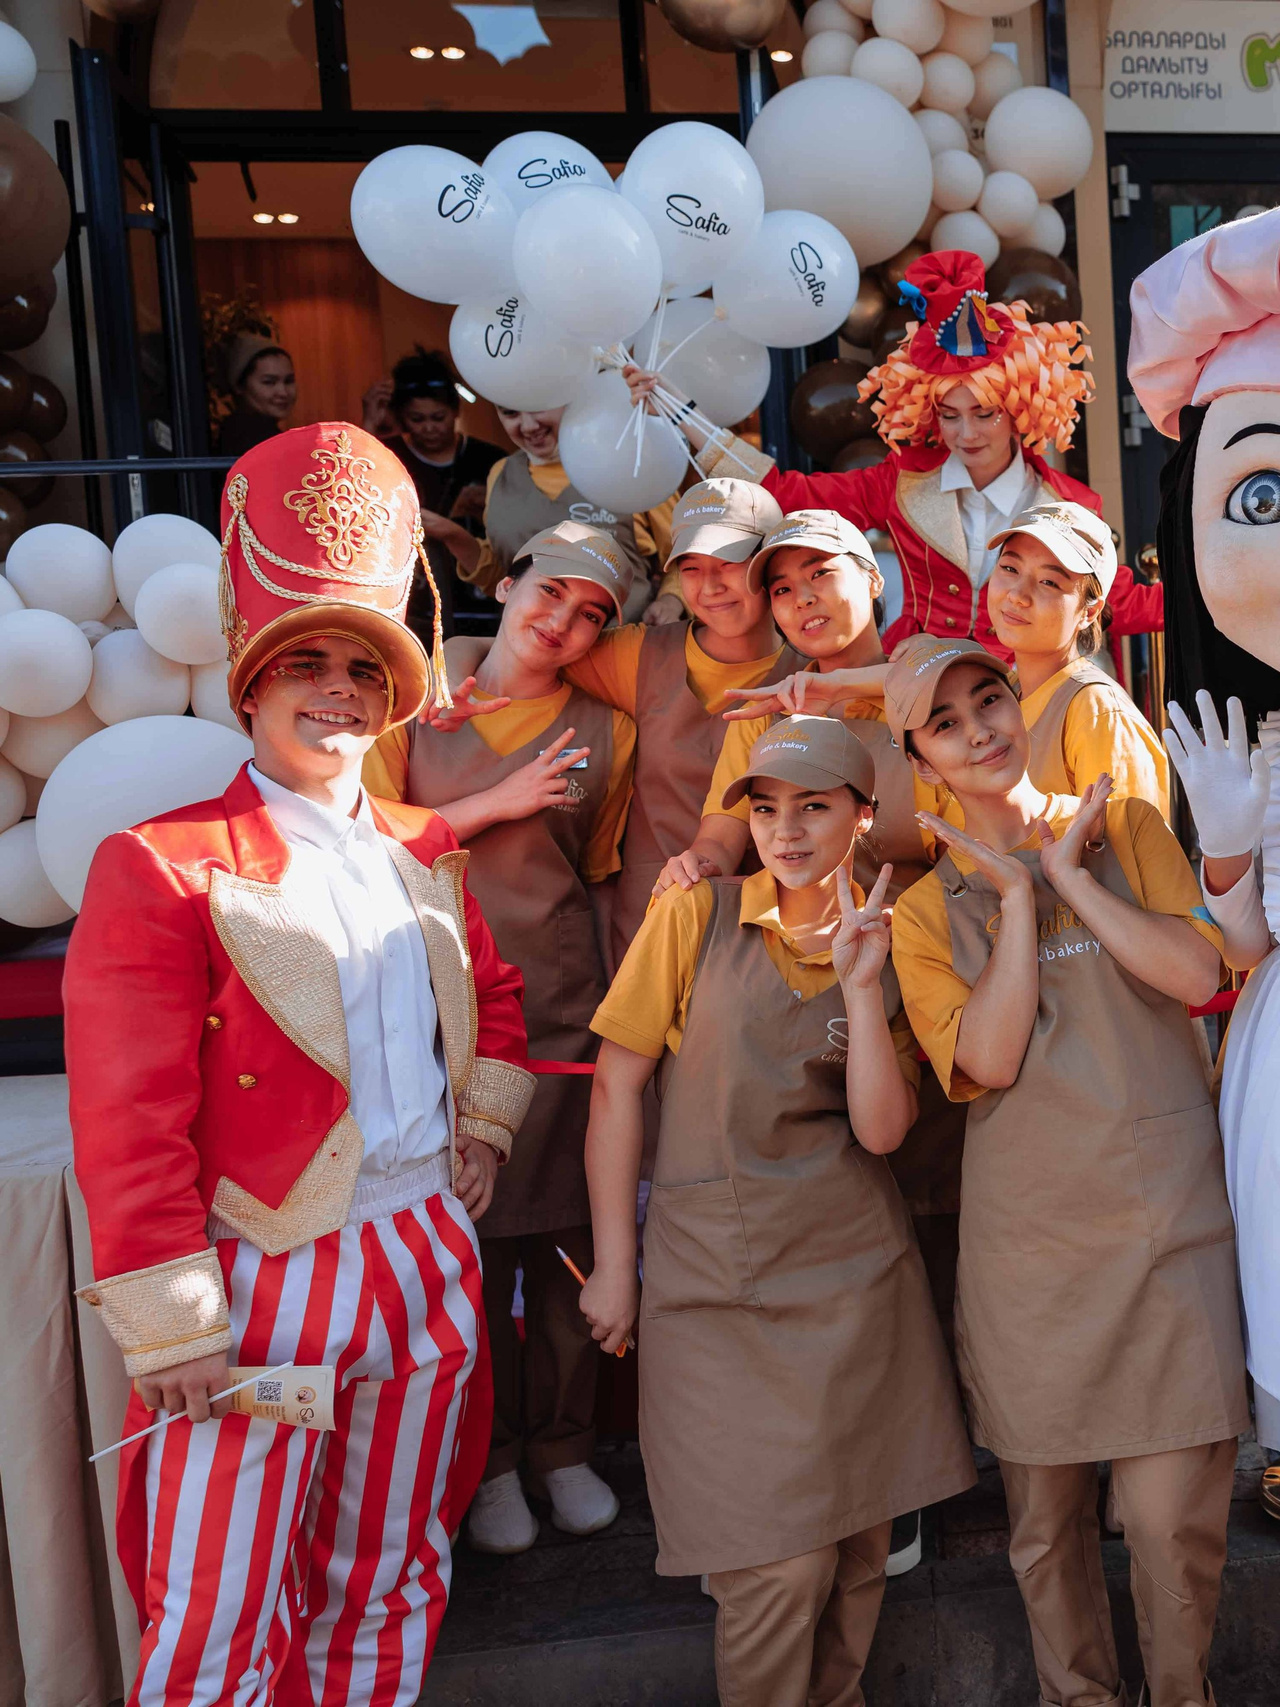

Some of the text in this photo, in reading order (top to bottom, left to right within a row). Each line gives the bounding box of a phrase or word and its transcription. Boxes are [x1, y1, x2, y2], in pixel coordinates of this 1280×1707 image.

[1121, 55, 1209, 75] ДАМЫТУ
[518, 158, 586, 189] Safia
[437, 173, 485, 224] Safia
[665, 194, 731, 236] Safia
[790, 241, 827, 307] Safia
[484, 297, 519, 358] Safia
[935, 649, 962, 661] bakery
[781, 741, 809, 752] bakery
